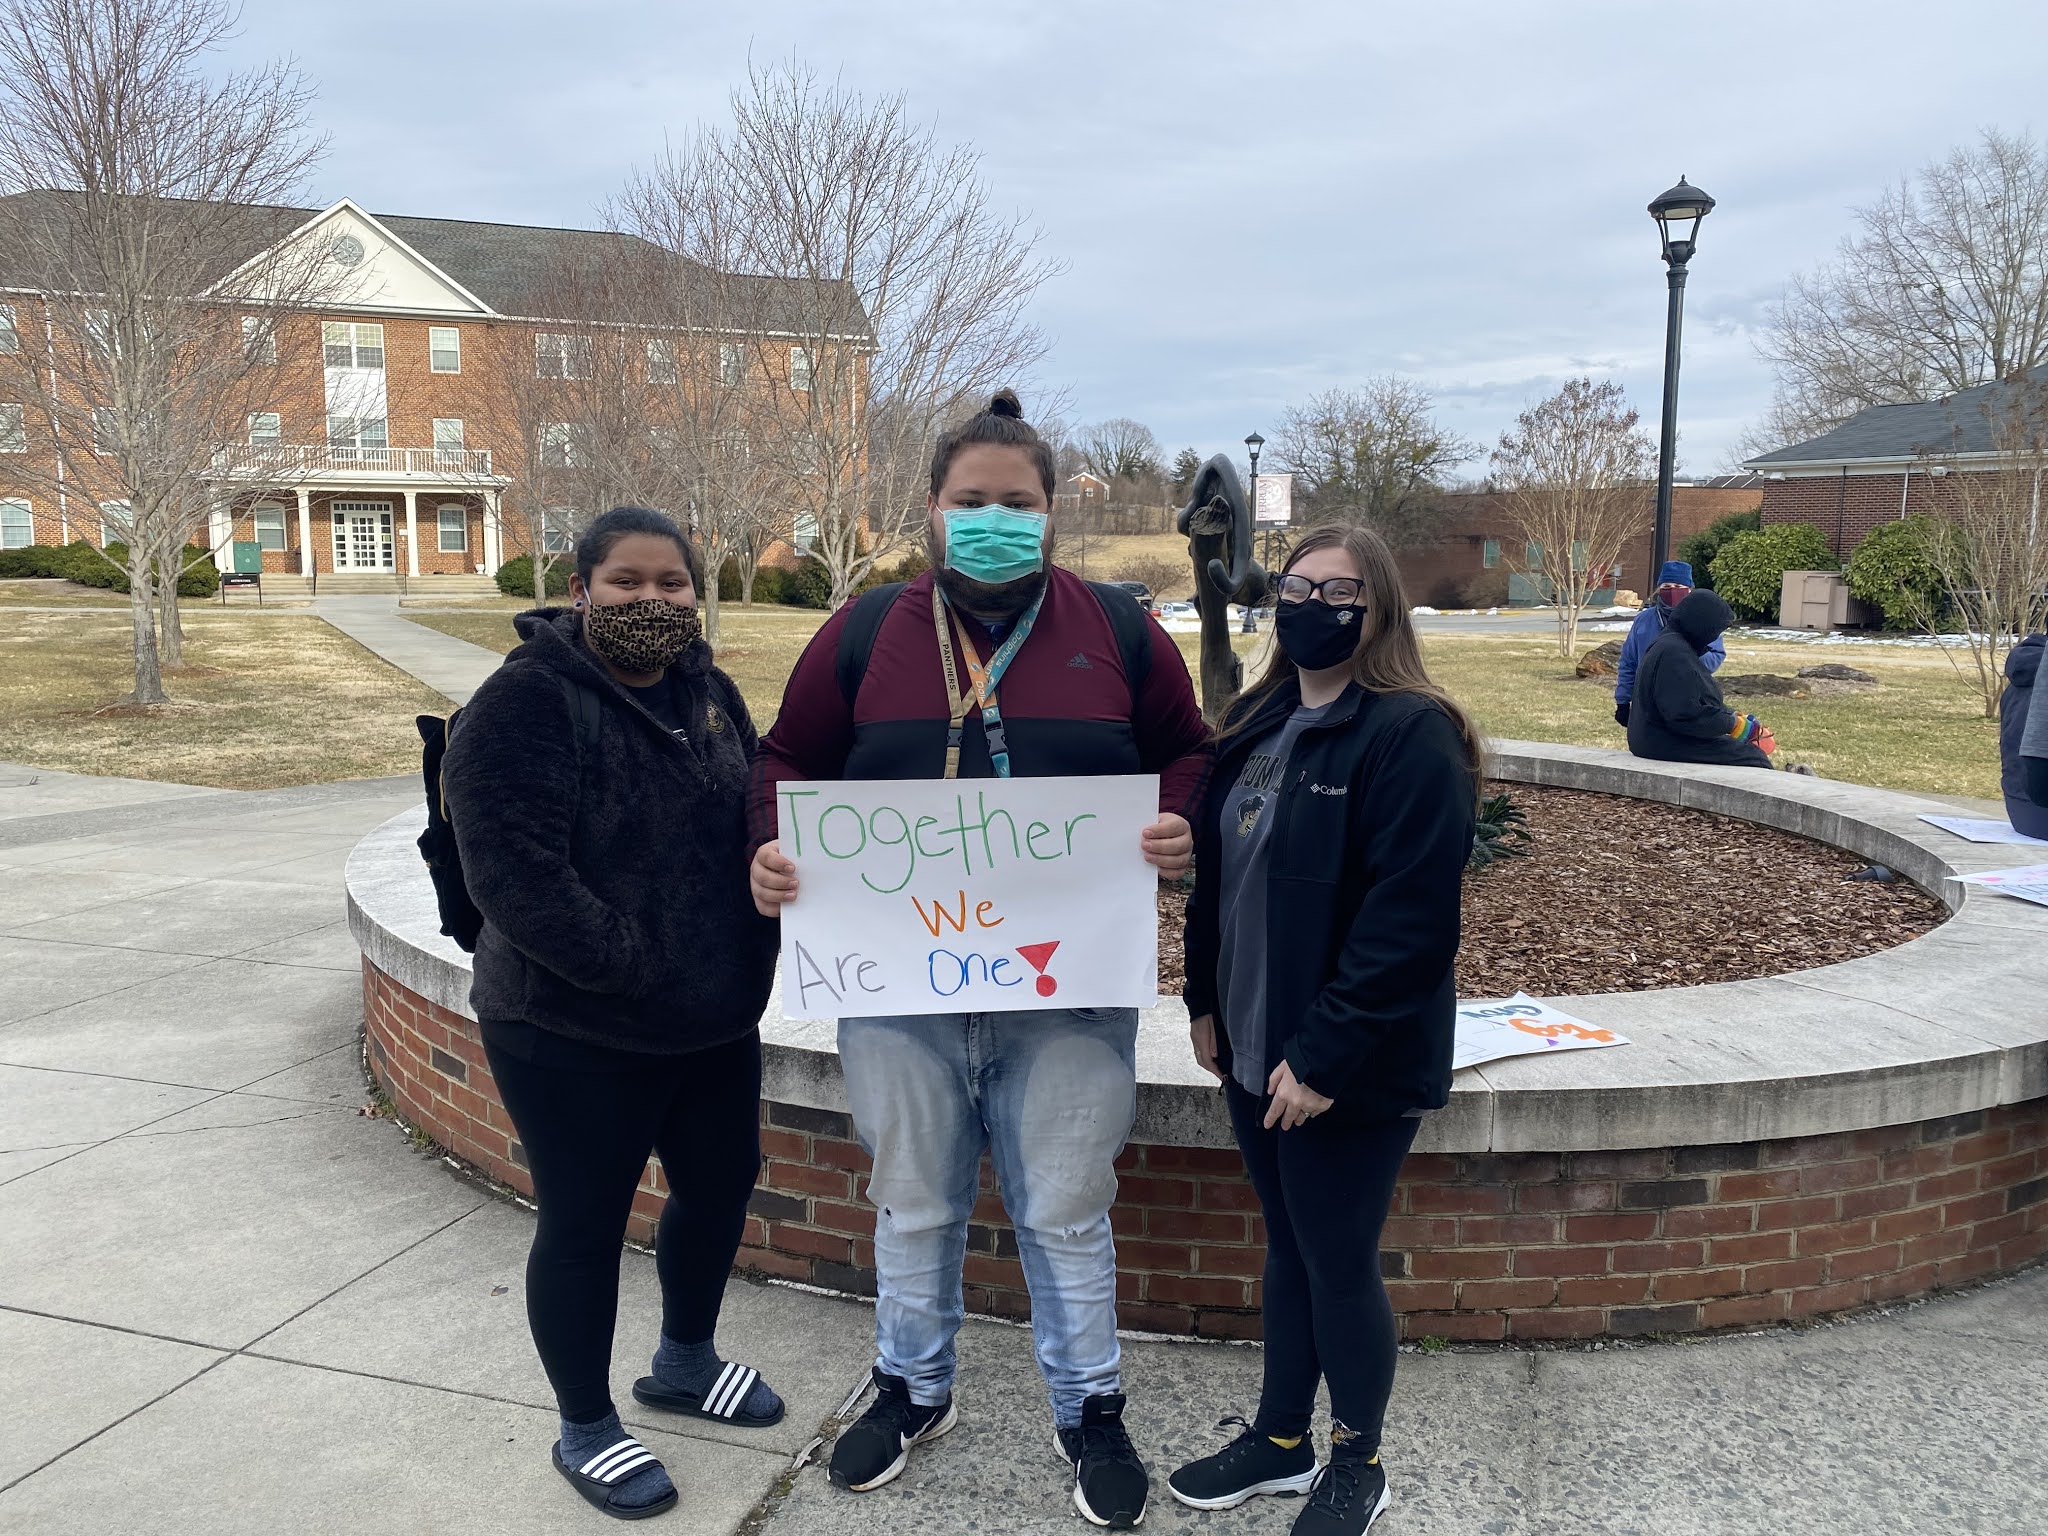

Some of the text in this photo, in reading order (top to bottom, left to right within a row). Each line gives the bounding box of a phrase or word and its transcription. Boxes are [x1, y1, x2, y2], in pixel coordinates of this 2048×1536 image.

[942, 643, 957, 691] PANTHERS
[995, 631, 1023, 667] Dolphins
[776, 791, 1097, 894] Together
[911, 889, 1005, 937] We
[795, 940, 886, 1010] Are
